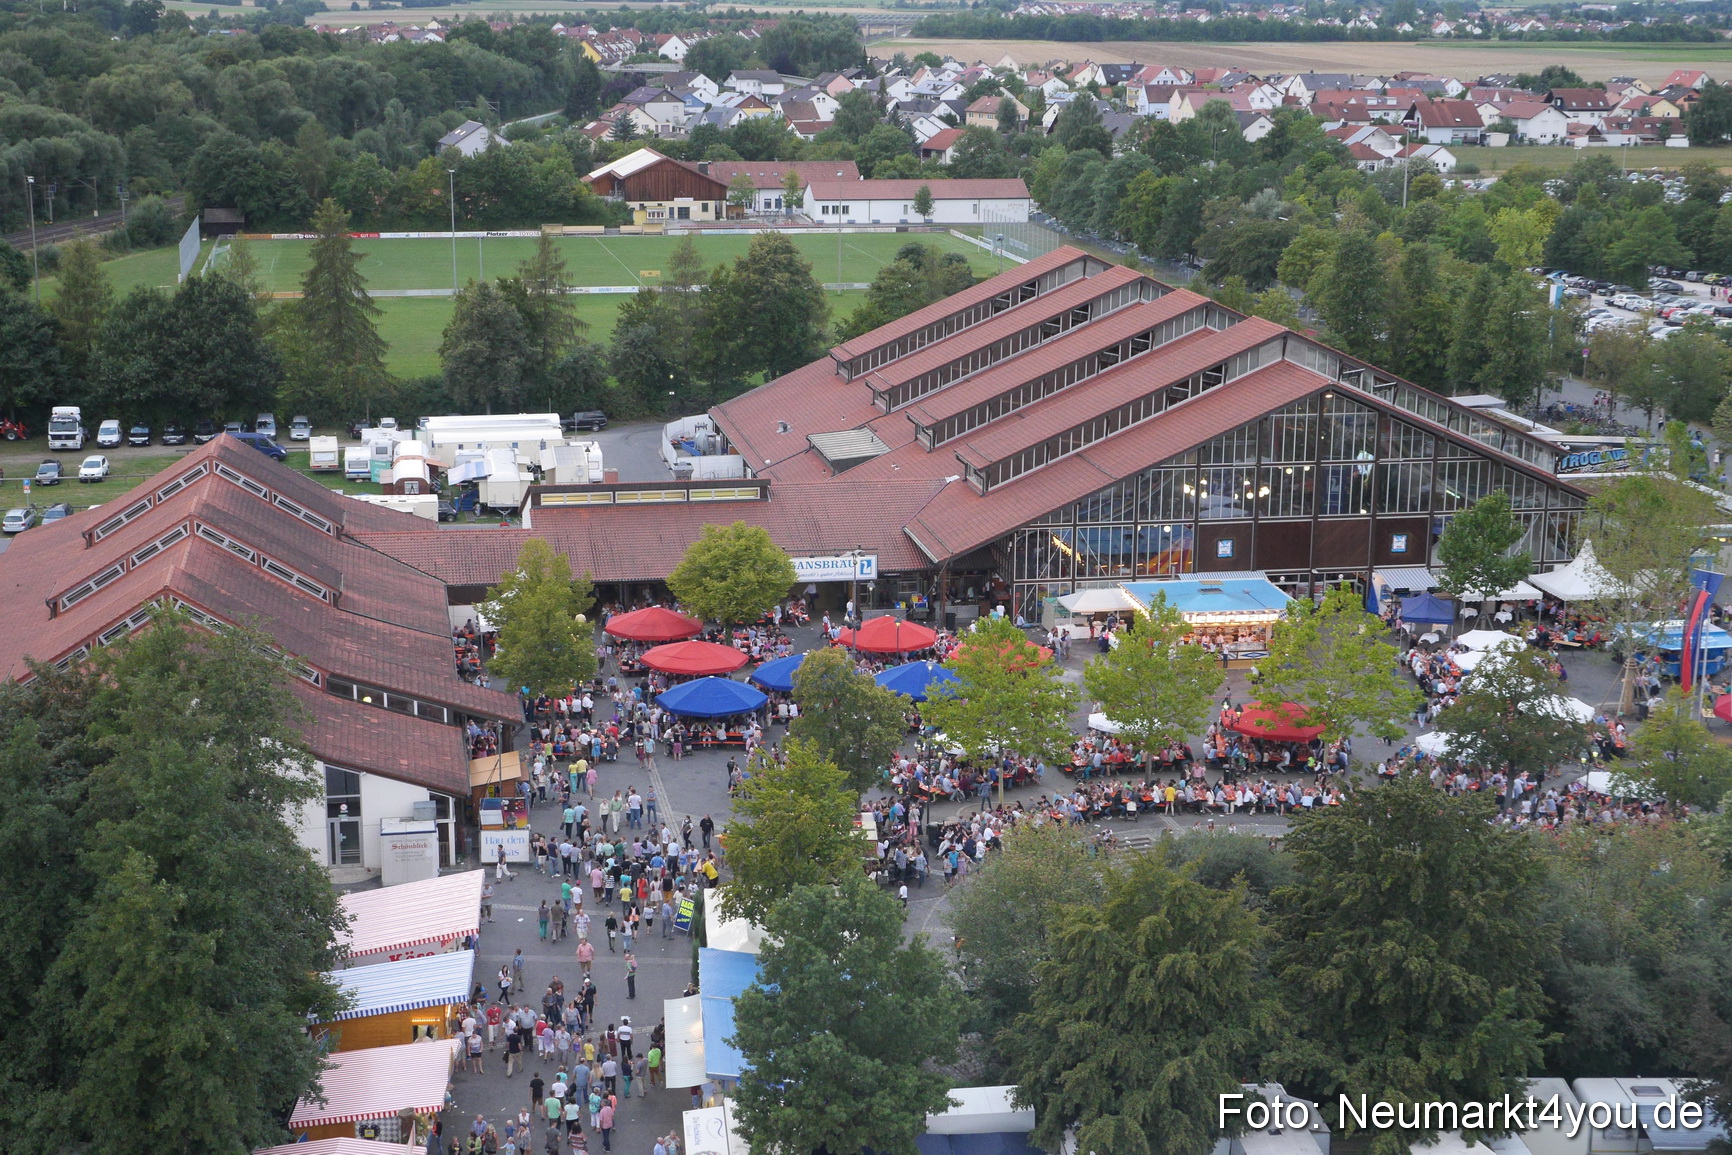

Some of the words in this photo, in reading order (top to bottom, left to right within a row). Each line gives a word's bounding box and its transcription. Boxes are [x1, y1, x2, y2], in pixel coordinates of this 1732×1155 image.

[1561, 449, 1627, 469] TROGLAUE
[485, 836, 504, 845] Hau
[507, 835, 525, 844] den
[391, 841, 429, 851] Schönblick
[491, 848, 520, 857] Lkas
